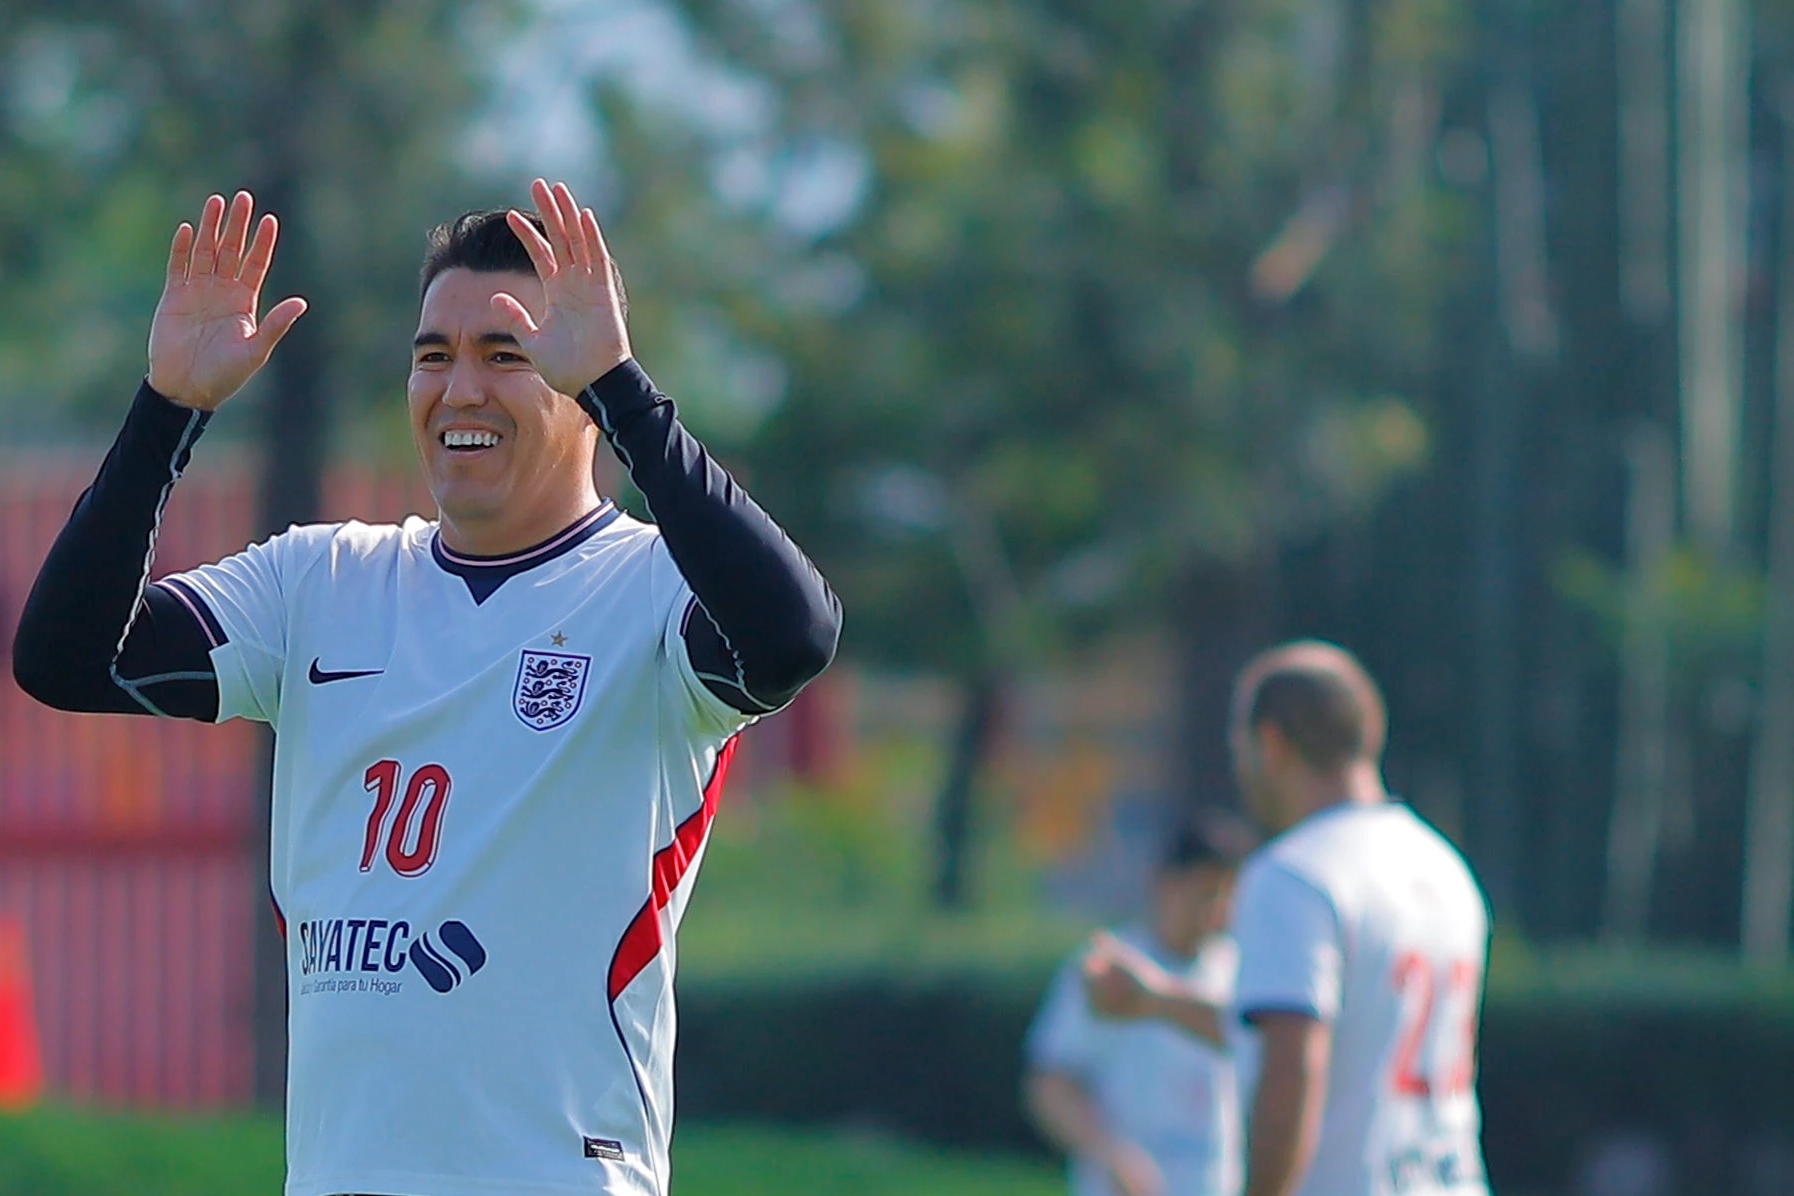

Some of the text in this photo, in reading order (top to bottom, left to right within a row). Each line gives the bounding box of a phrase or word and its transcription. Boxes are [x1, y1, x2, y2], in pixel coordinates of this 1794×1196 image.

[358, 759, 452, 878] 10
[300, 919, 410, 976] SAYATEC
[337, 979, 357, 995] para
[358, 978, 369, 992] tu
[371, 978, 404, 996] Hogar
